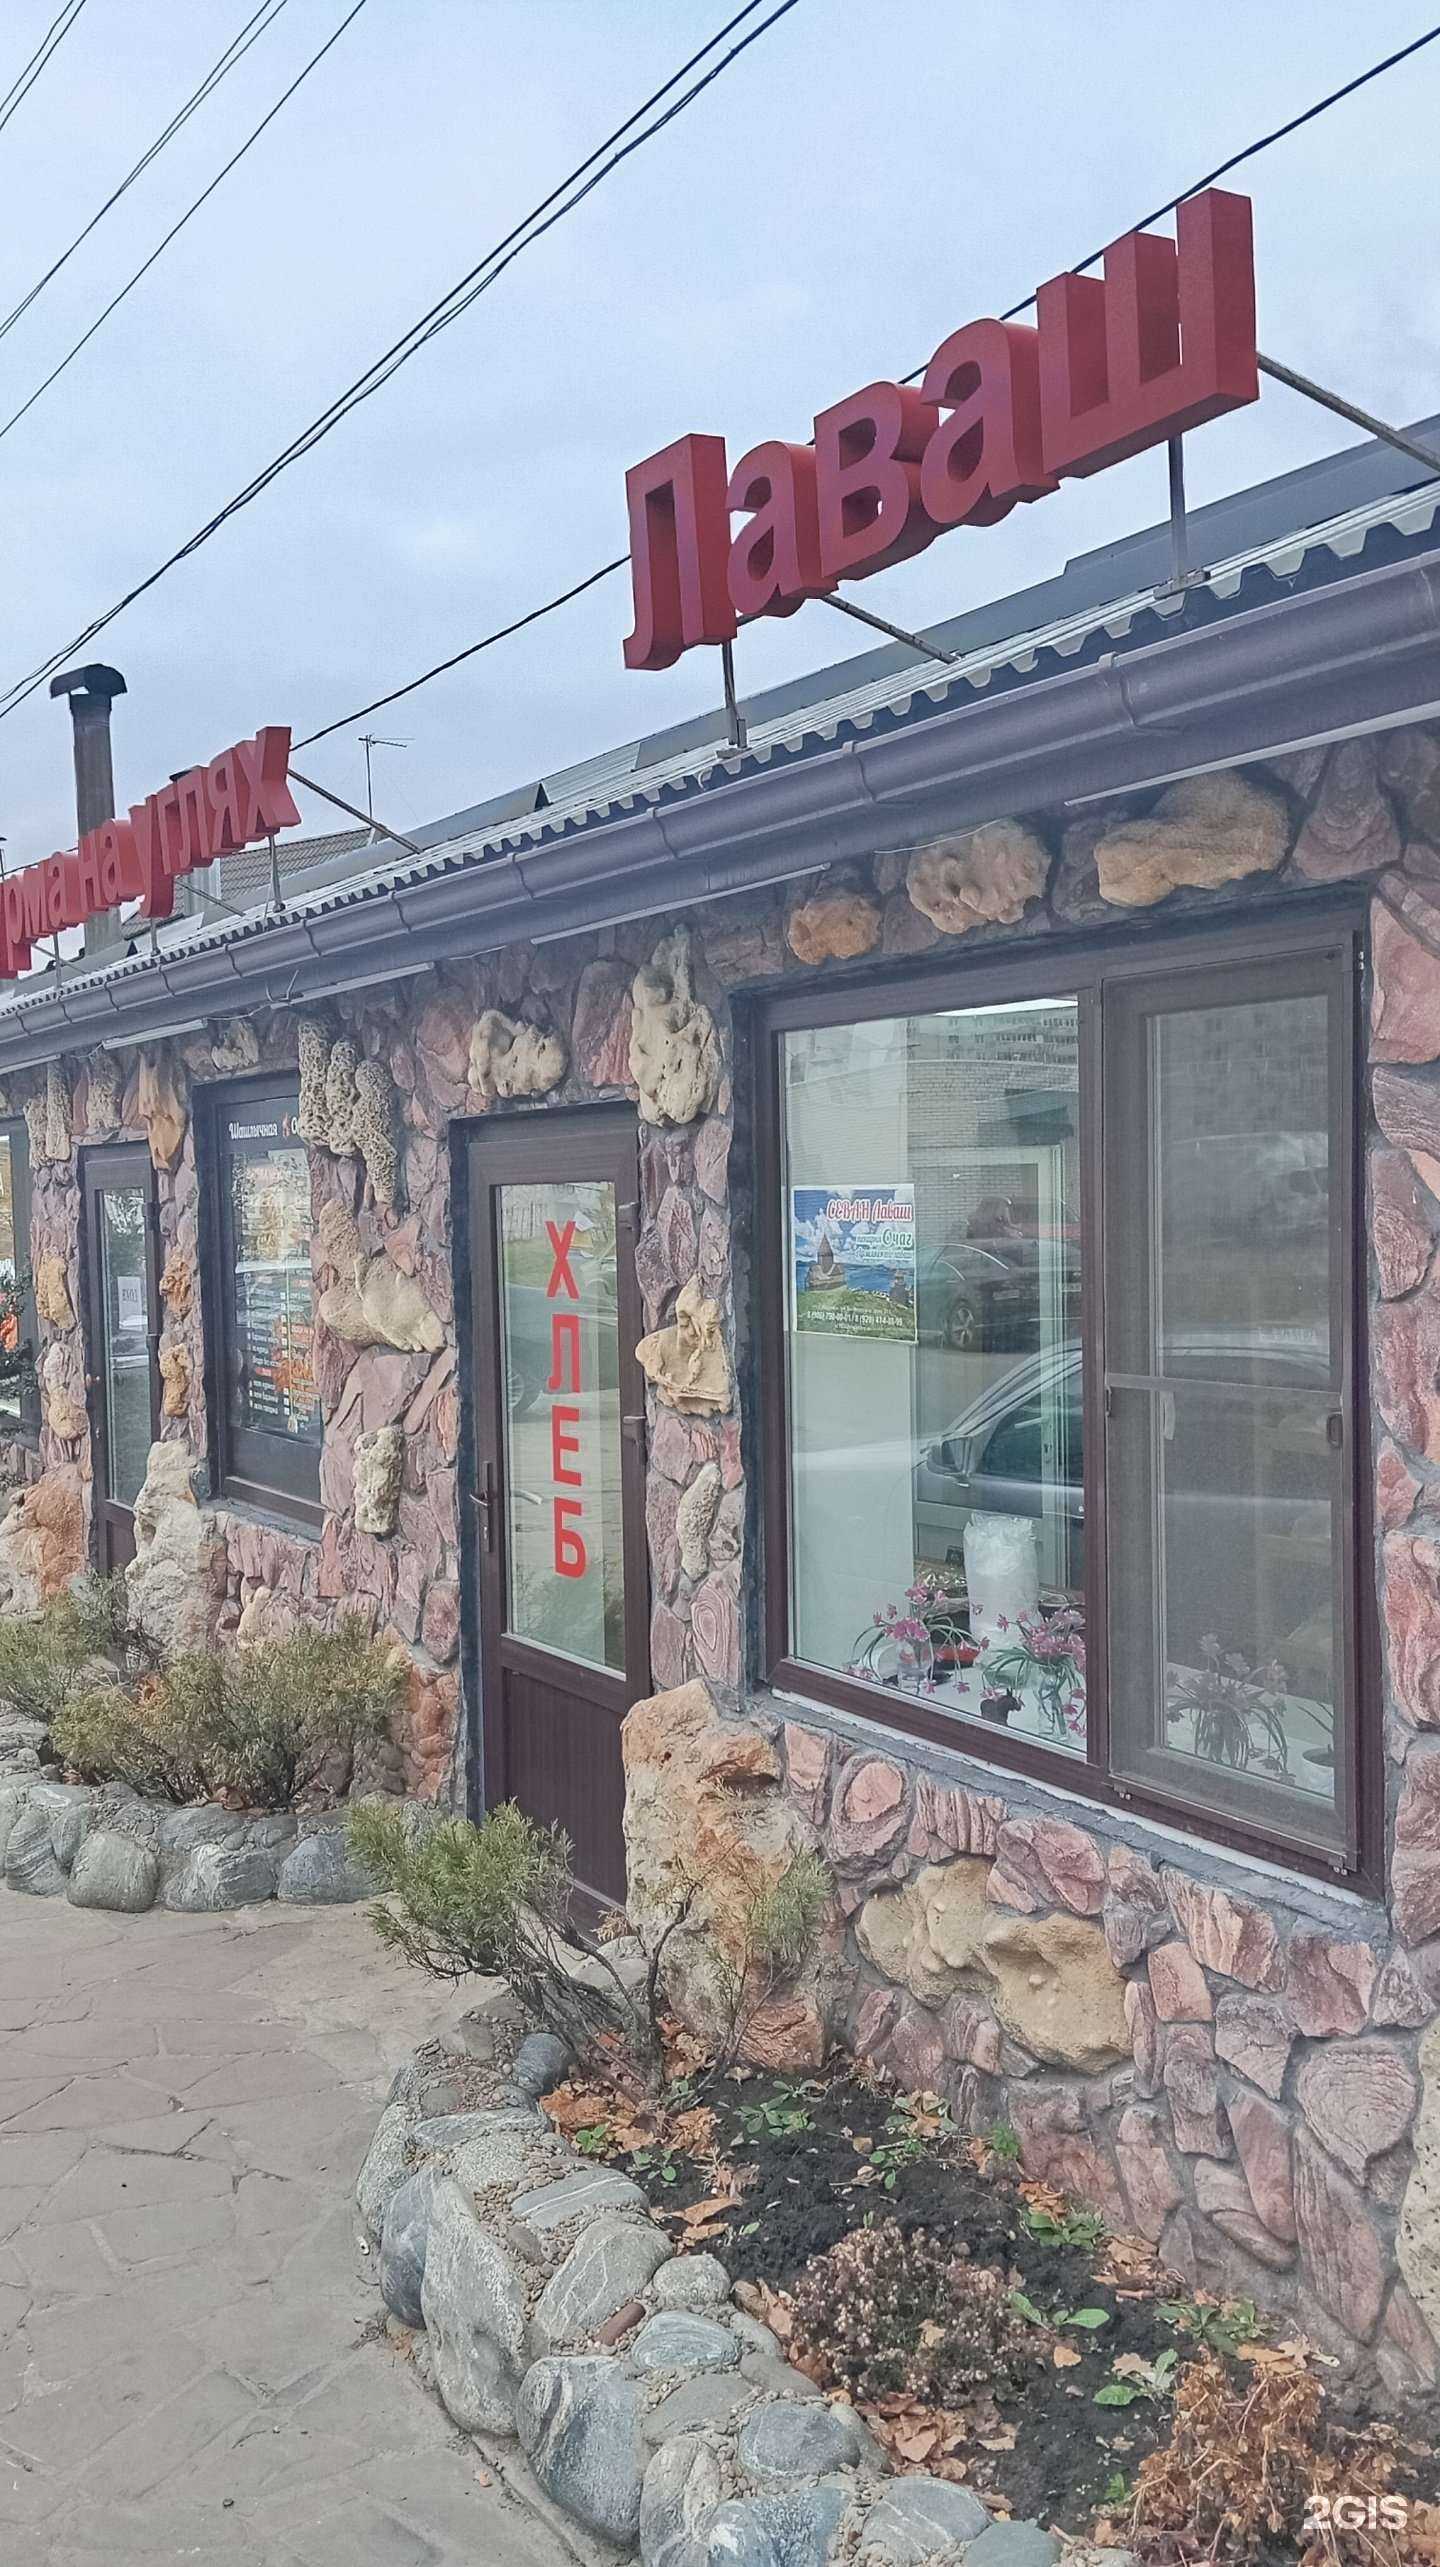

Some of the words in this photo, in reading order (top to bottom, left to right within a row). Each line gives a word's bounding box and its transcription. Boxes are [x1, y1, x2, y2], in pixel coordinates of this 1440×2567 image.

[623, 186, 1260, 670] Лаваш
[0, 850, 90, 979] рма
[77, 818, 146, 912] на
[128, 726, 302, 919] углях
[545, 1220, 588, 1579] ХЛЕБ
